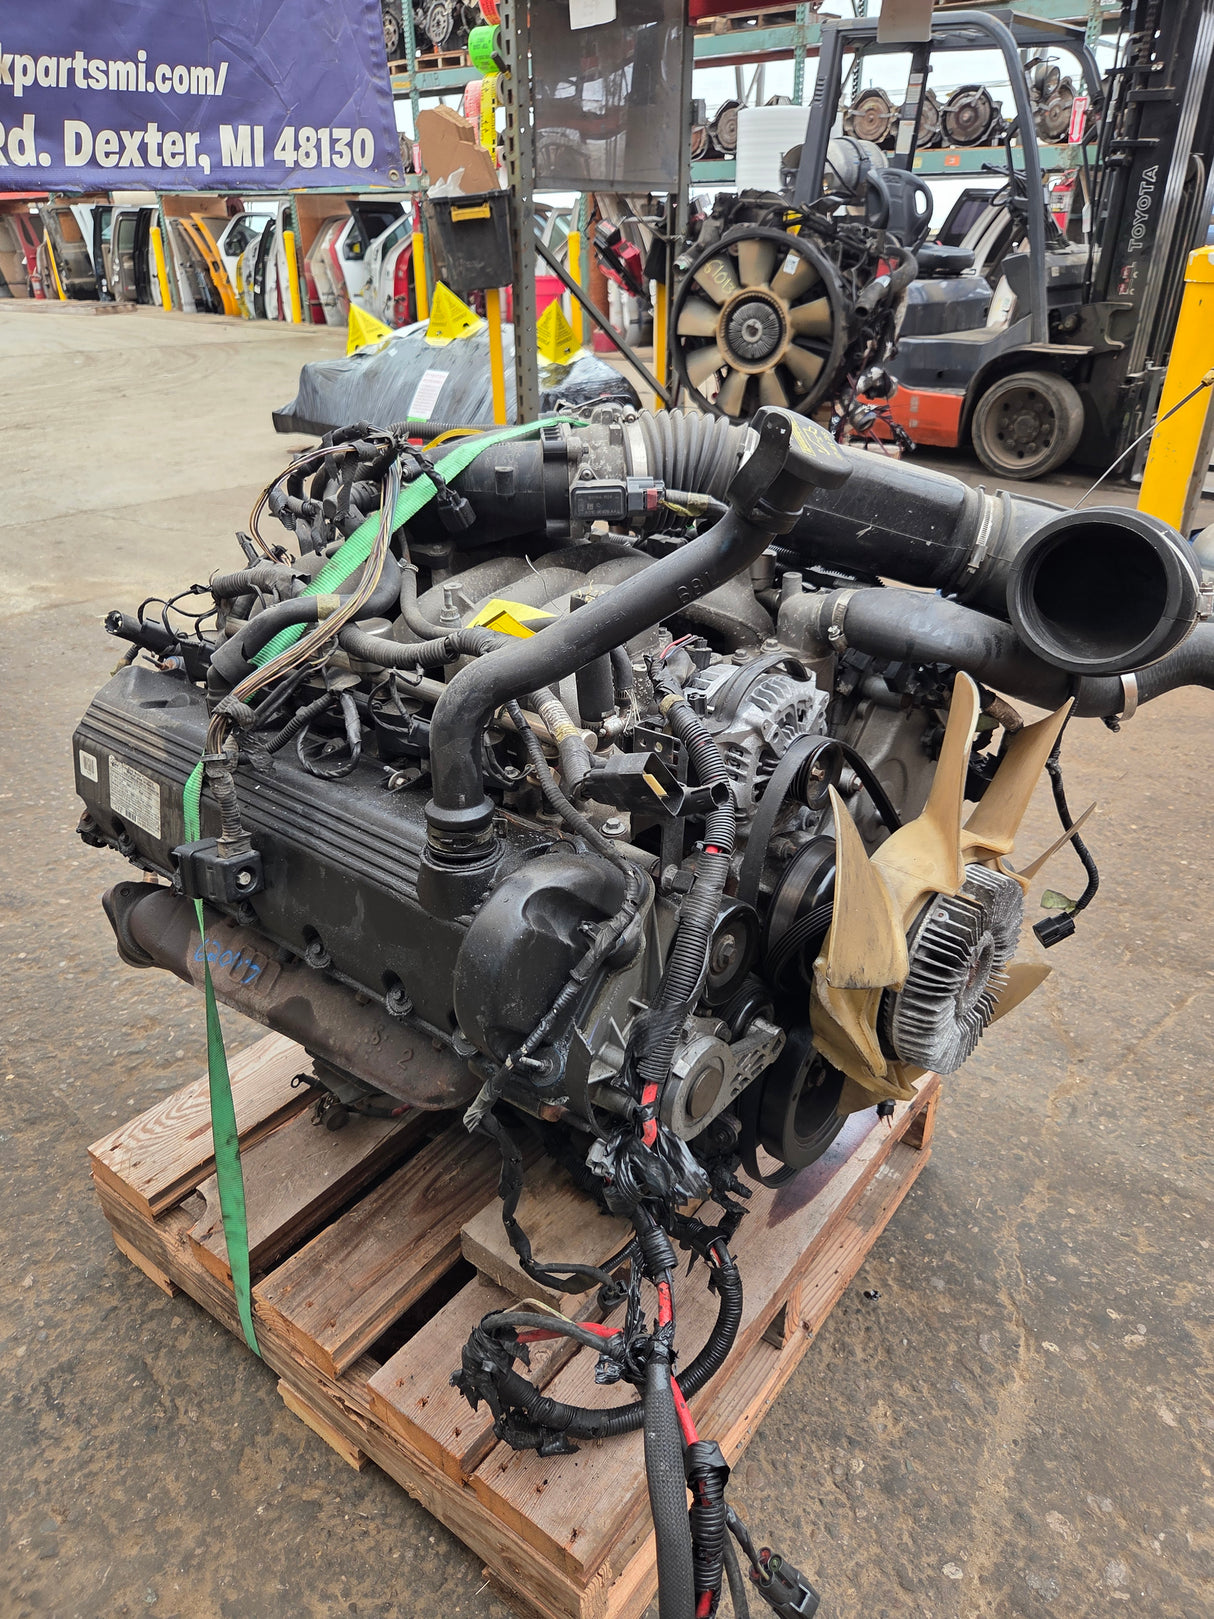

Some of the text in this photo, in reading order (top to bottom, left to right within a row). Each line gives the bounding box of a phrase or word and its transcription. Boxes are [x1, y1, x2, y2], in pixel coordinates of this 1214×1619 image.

[0, 43, 229, 97] kpartsmi.com/
[64, 119, 211, 175] Dexter,
[219, 124, 265, 168] MI
[273, 126, 375, 169] 48130
[1128, 165, 1159, 253] TOYOTA
